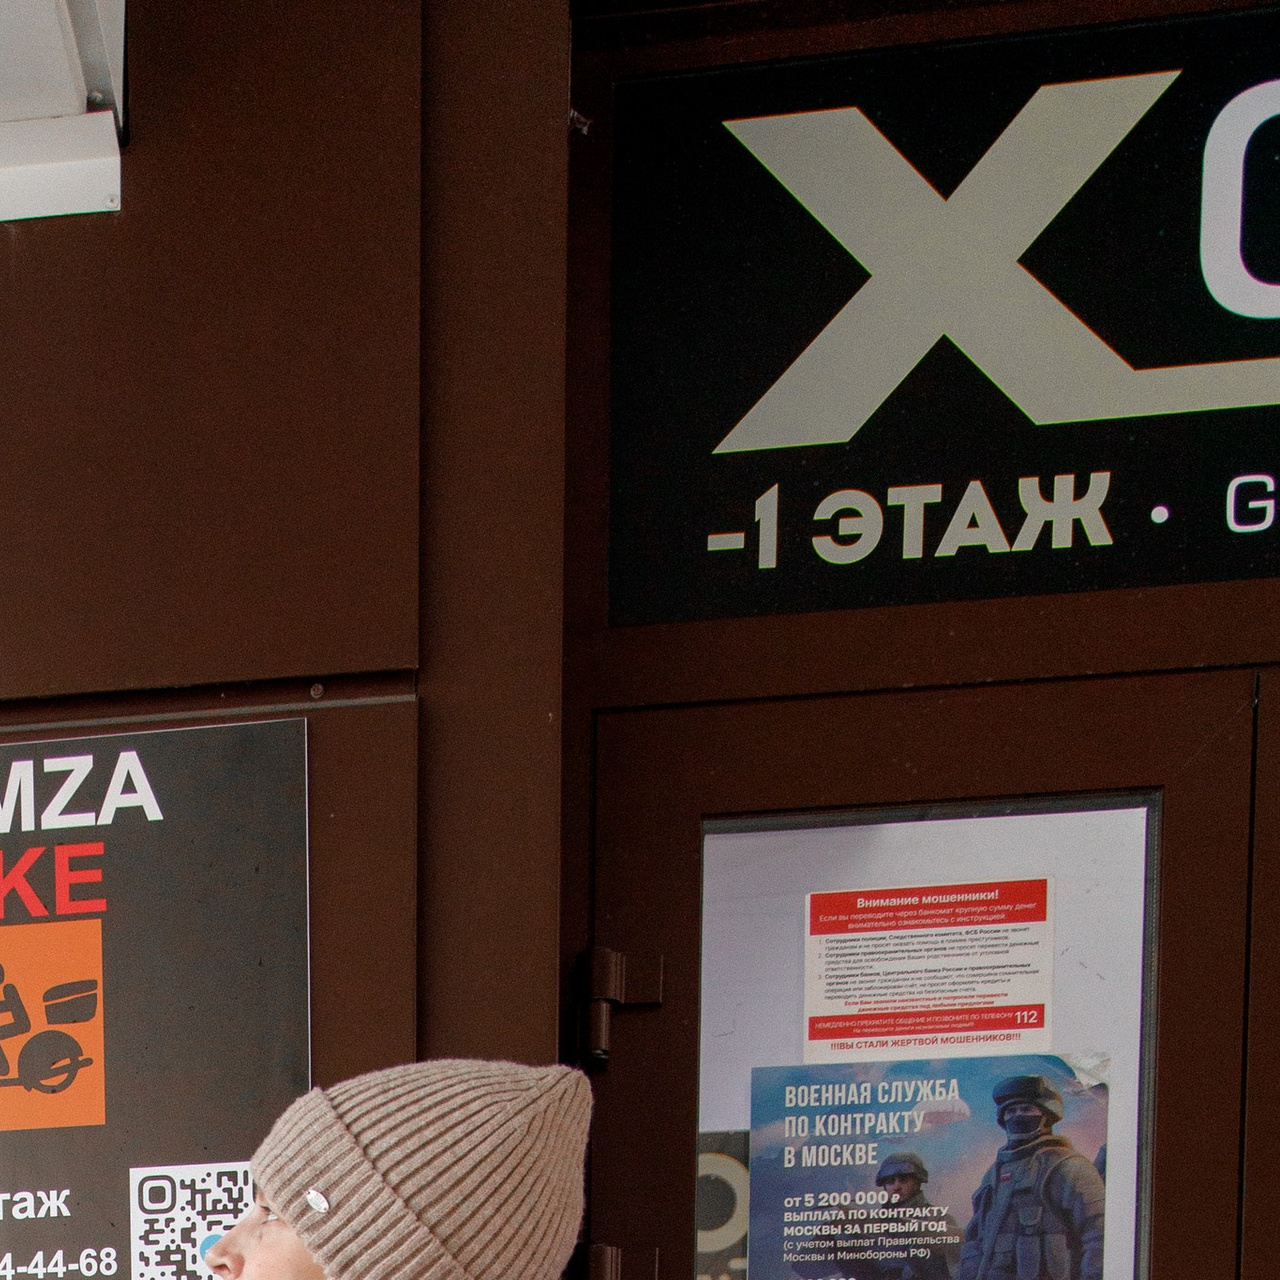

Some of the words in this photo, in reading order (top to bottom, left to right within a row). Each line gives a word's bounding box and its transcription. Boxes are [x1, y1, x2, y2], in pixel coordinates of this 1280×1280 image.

[707, 482, 779, 569] -1
[812, 471, 1113, 564] ЭТАЖ
[857, 896, 919, 909] Внимание
[922, 889, 999, 905] мошенники!
[989, 904, 1013, 913] сумму
[1014, 1010, 1038, 1025] 112
[855, 1040, 889, 1049] СТАЛИ
[890, 1036, 938, 1047] ЖЕРТВОЙ
[785, 1082, 872, 1108] ВОЕННАЯ
[878, 1078, 960, 1104] СЛУЖБА
[784, 1115, 809, 1138] ПО
[815, 1110, 926, 1137] КОНТРАКТУ
[784, 1146, 796, 1168] В
[801, 1143, 879, 1167] МОСКВЕ
[784, 1197, 803, 1208] от
[804, 1193, 815, 1207] 5
[817, 1192, 851, 1206] 200
[855, 1191, 889, 1205] 000
[783, 1210, 846, 1222] ВЫПЛАТА
[848, 1209, 868, 1220] ПО
[869, 1206, 950, 1219] КОНТРАКТУ
[783, 1225, 842, 1237] МОСКВЫ
[844, 1224, 862, 1235] ЗА
[864, 1219, 919, 1234] ПЕРВЫЙ
[920, 1221, 948, 1233] ГОД
[783, 1239, 794, 1251] (с
[796, 1238, 834, 1251] учетом
[837, 1237, 875, 1248] выплат
[877, 1235, 960, 1248] Правительства
[783, 1252, 826, 1263] Москвы
[827, 1252, 835, 1260] и
[837, 1249, 908, 1261] Минобороны
[909, 1247, 931, 1260] РФ)
